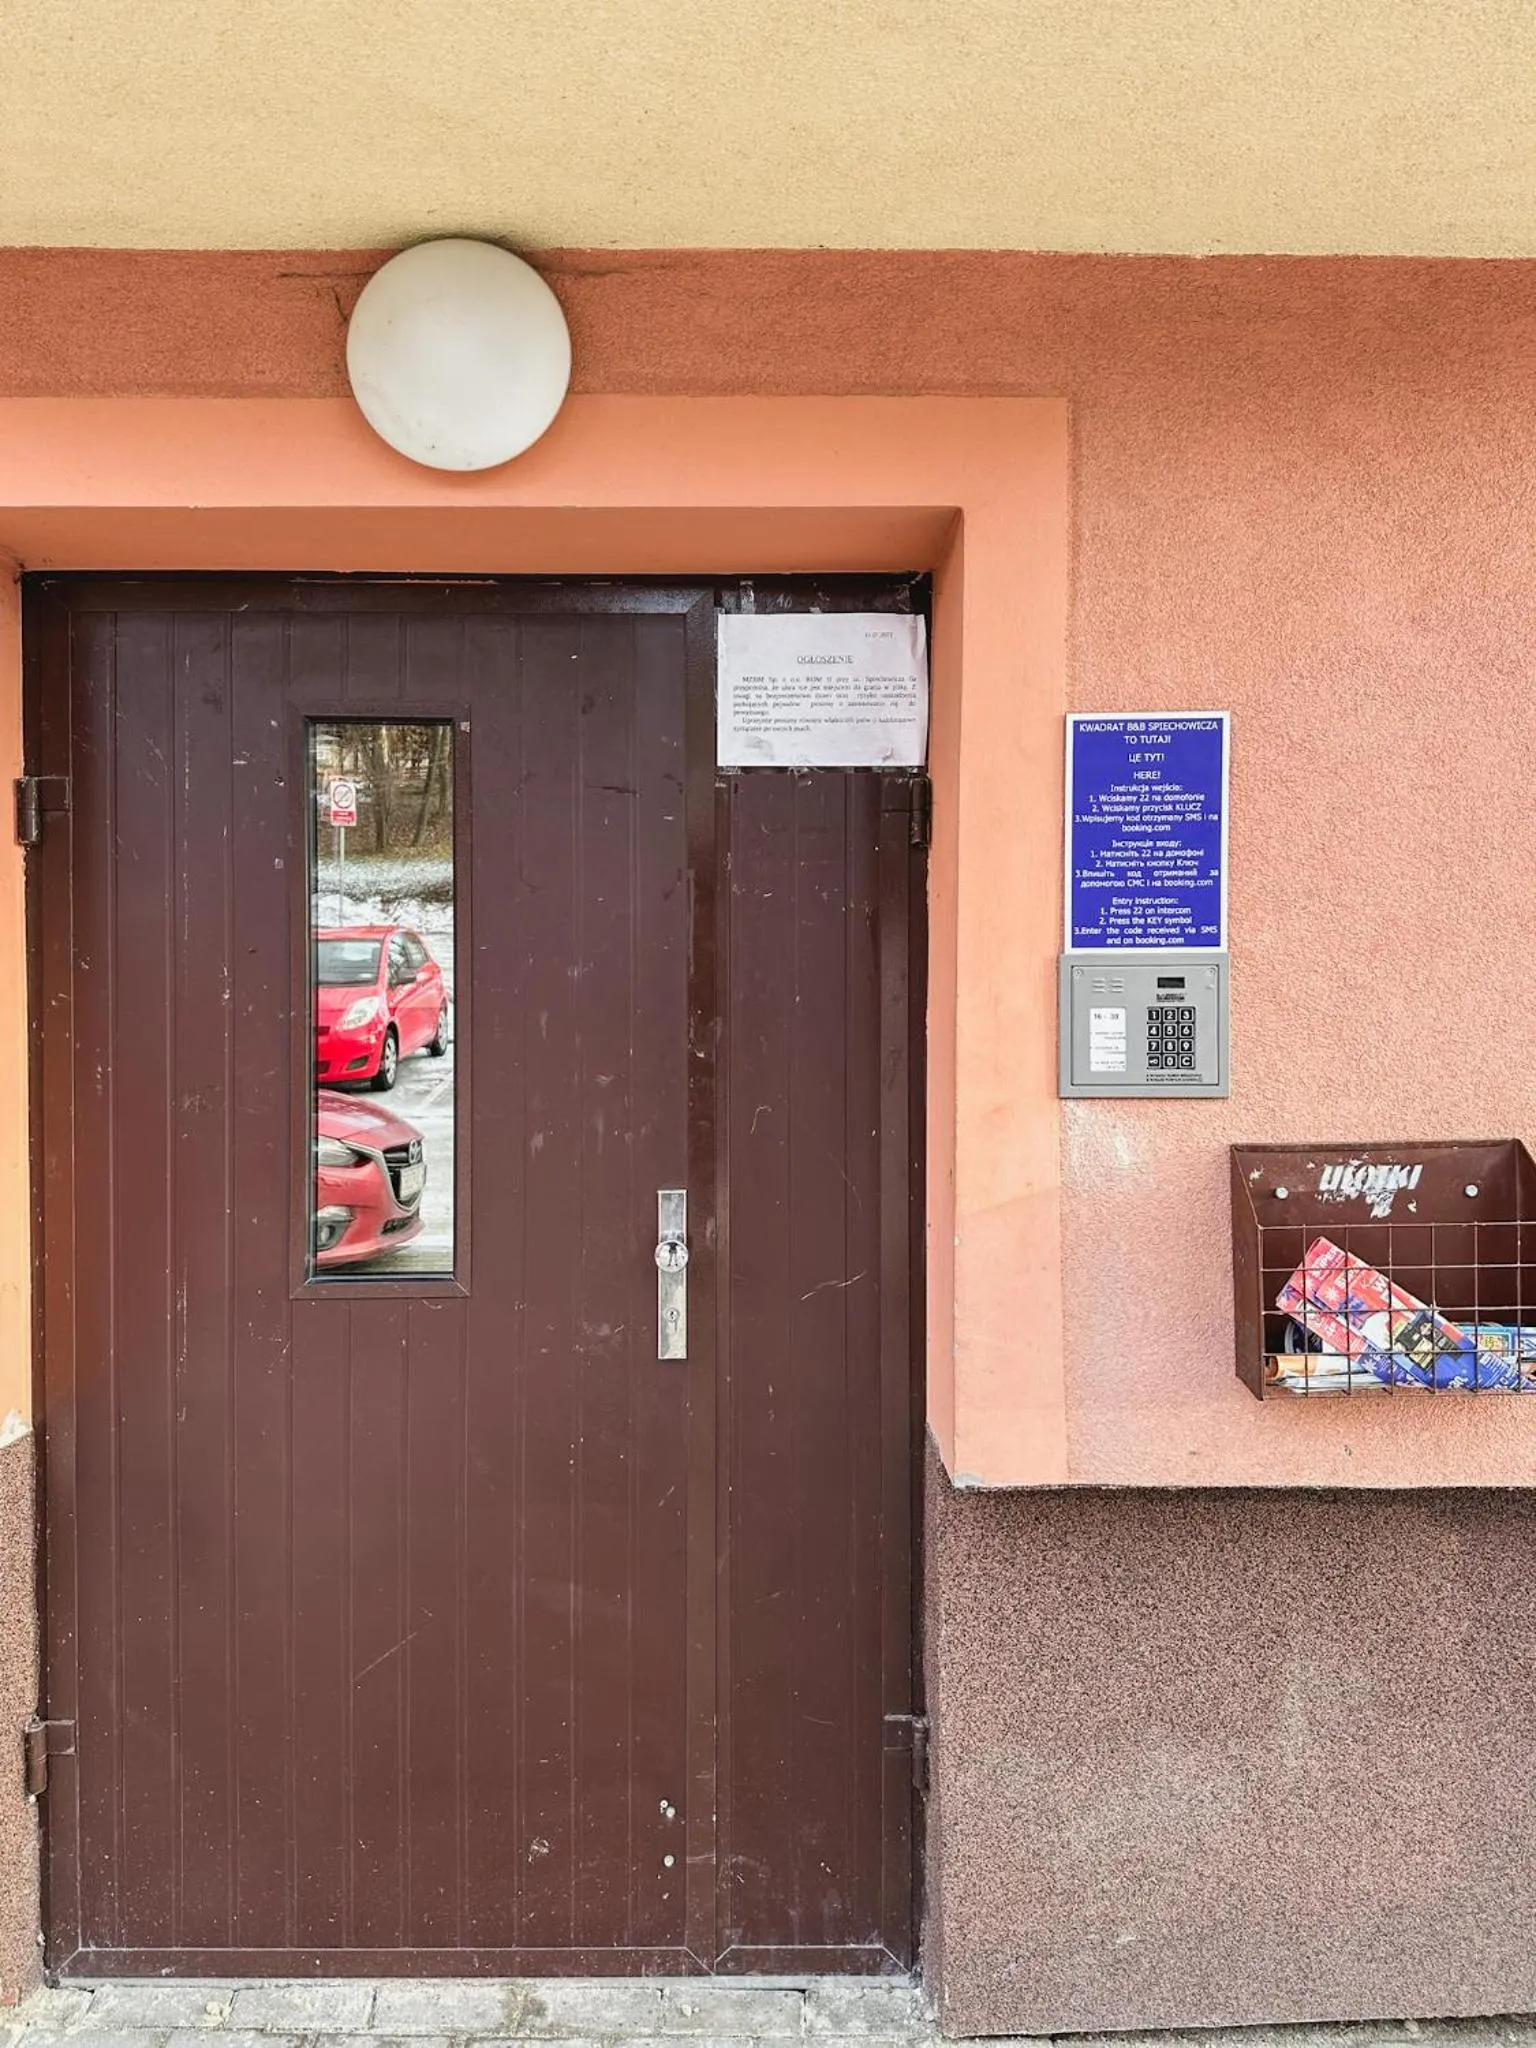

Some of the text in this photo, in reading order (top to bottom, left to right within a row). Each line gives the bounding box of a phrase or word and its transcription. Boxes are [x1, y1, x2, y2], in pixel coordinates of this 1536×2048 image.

[797, 655, 854, 664] OGŁOSZENIE
[1080, 721, 1218, 732] KWADRAT B&B SPIECHOWICZA
[1124, 735, 1171, 744] TO TUTAJ!
[1133, 771, 1161, 779] HERE!
[1110, 784, 1150, 792] Instrukcja
[1099, 794, 1138, 803] Wciskamy
[1102, 804, 1140, 813] Wciskamy
[1142, 804, 1174, 812] przycisk
[1122, 824, 1171, 833] booking.com
[1164, 879, 1213, 888] booking.com
[1112, 897, 1133, 906] Entry
[1164, 917, 1192, 925] symbol
[1135, 936, 1184, 946] booking.com
